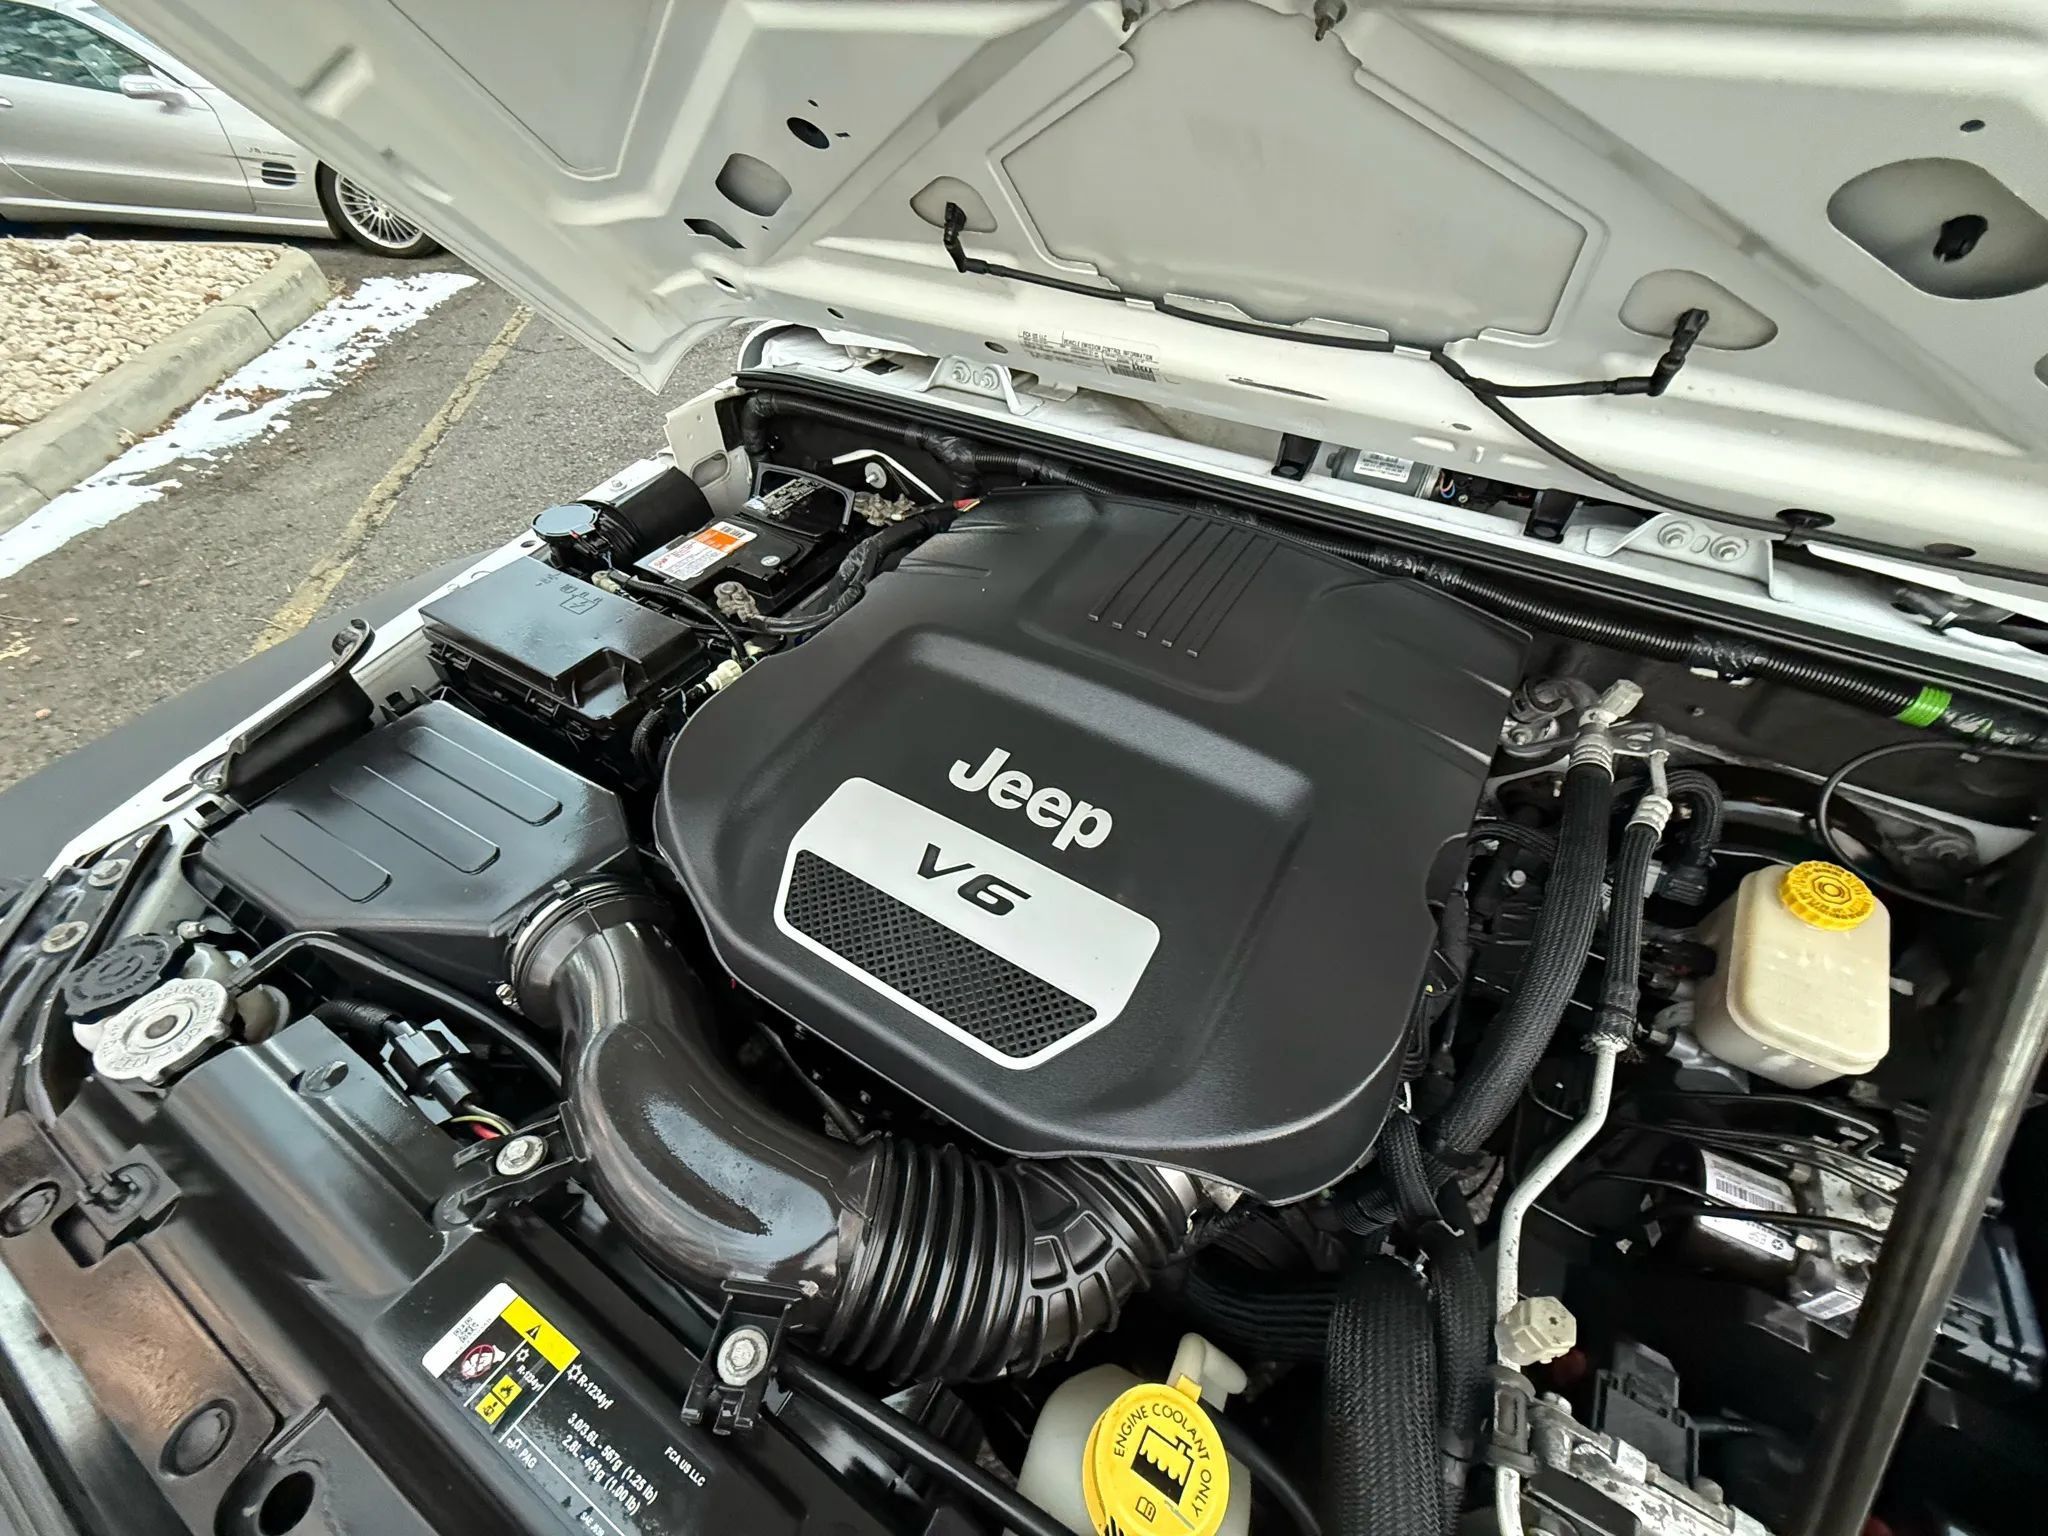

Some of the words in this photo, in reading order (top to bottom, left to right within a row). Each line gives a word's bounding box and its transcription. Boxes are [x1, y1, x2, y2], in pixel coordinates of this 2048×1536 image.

[1102, 345, 1121, 355] CONTROL
[1123, 349, 1153, 361] INFORMATION
[948, 747, 1113, 851] Jeep
[916, 842, 1032, 916] V6
[577, 1374, 614, 1410] R-1234yf
[518, 1448, 538, 1469] PAG
[562, 1434, 583, 1458] 2.8L
[583, 1455, 606, 1483] 451g
[603, 1476, 629, 1502] (1.00
[625, 1493, 641, 1516] lb)
[567, 1412, 599, 1448] 3.0/3.6L
[600, 1444, 623, 1472] 567g
[621, 1465, 647, 1492] (1.25
[641, 1482, 658, 1505] lb)
[664, 1446, 680, 1465] FCA
[679, 1459, 692, 1475] US
[688, 1470, 706, 1487] LLC
[1113, 1405, 1149, 1458] ENGINE
[1152, 1402, 1210, 1461] COOLANT
[1191, 1469, 1212, 1517] ONLY
[580, 1511, 595, 1526] SAE
